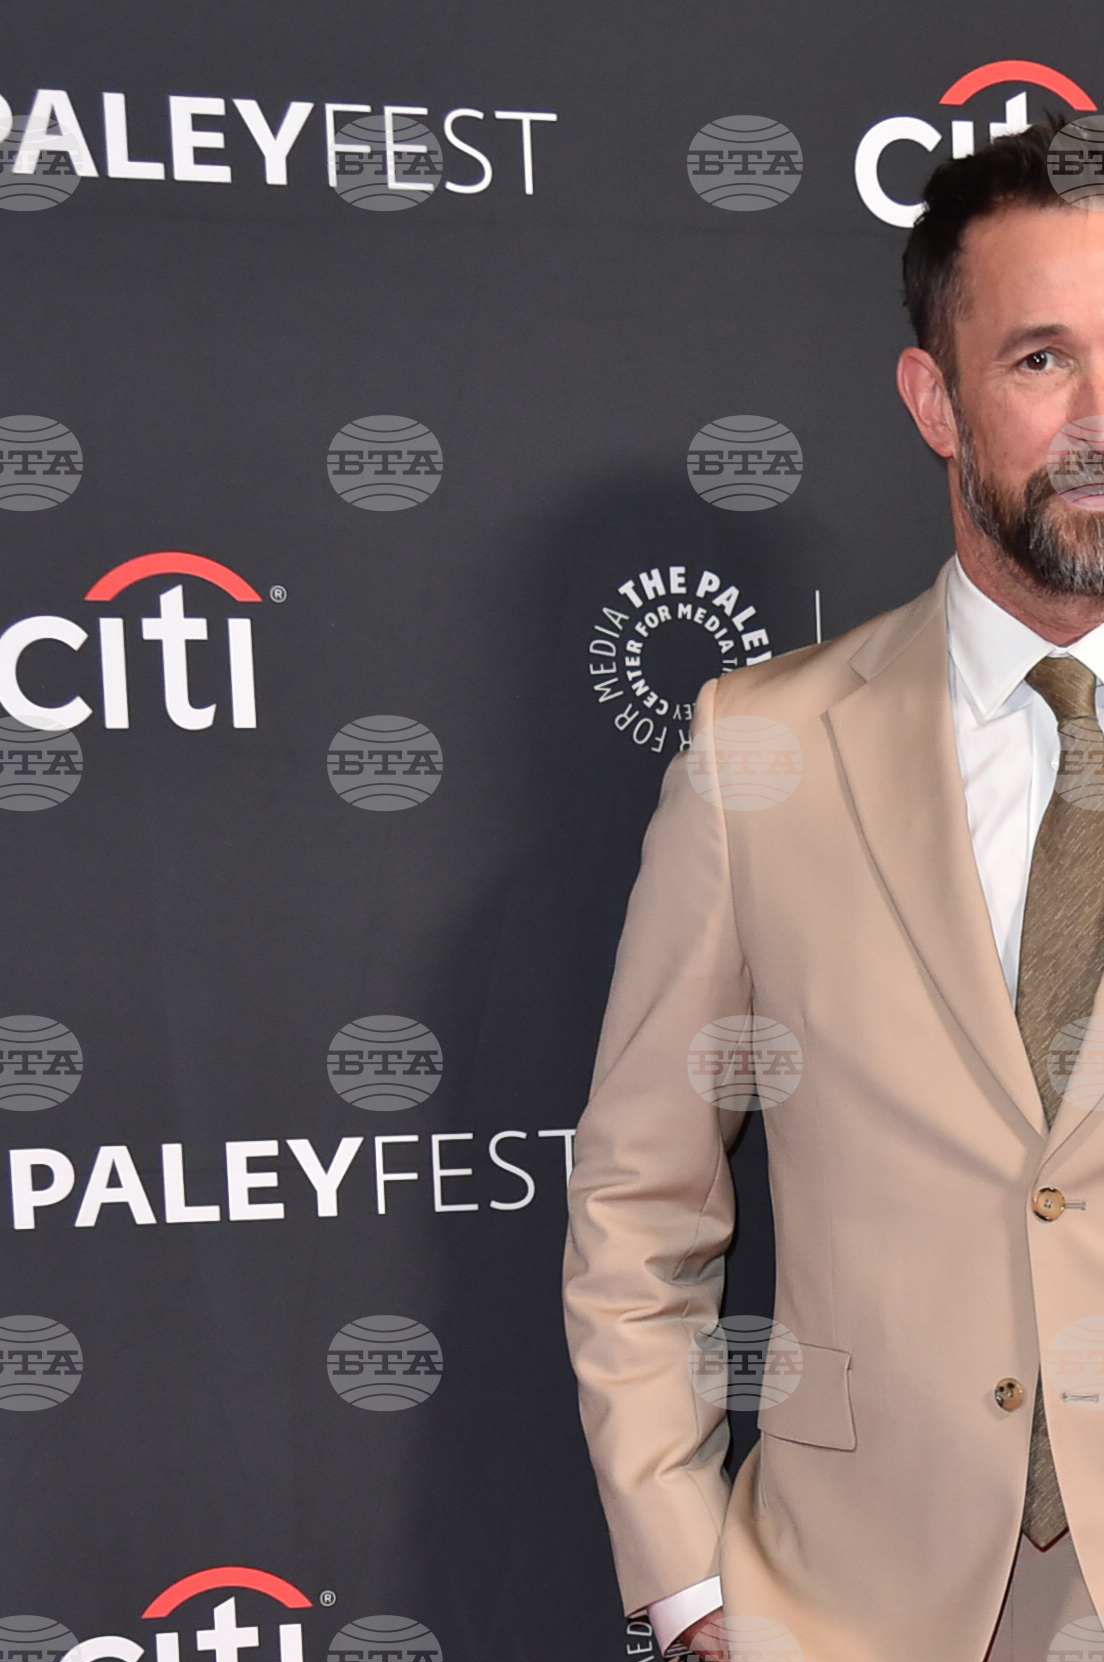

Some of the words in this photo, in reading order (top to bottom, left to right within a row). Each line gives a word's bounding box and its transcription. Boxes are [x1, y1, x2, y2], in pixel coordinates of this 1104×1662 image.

[0, 89, 557, 195] ALEYFEST
[618, 566, 687, 609] THE
[635, 605, 671, 637] FOR
[678, 603, 734, 654] MEDIA
[0, 583, 258, 732] citi
[590, 607, 629, 703] MEDIA
[625, 639, 669, 715] CENTER
[614, 703, 667, 752] FOR
